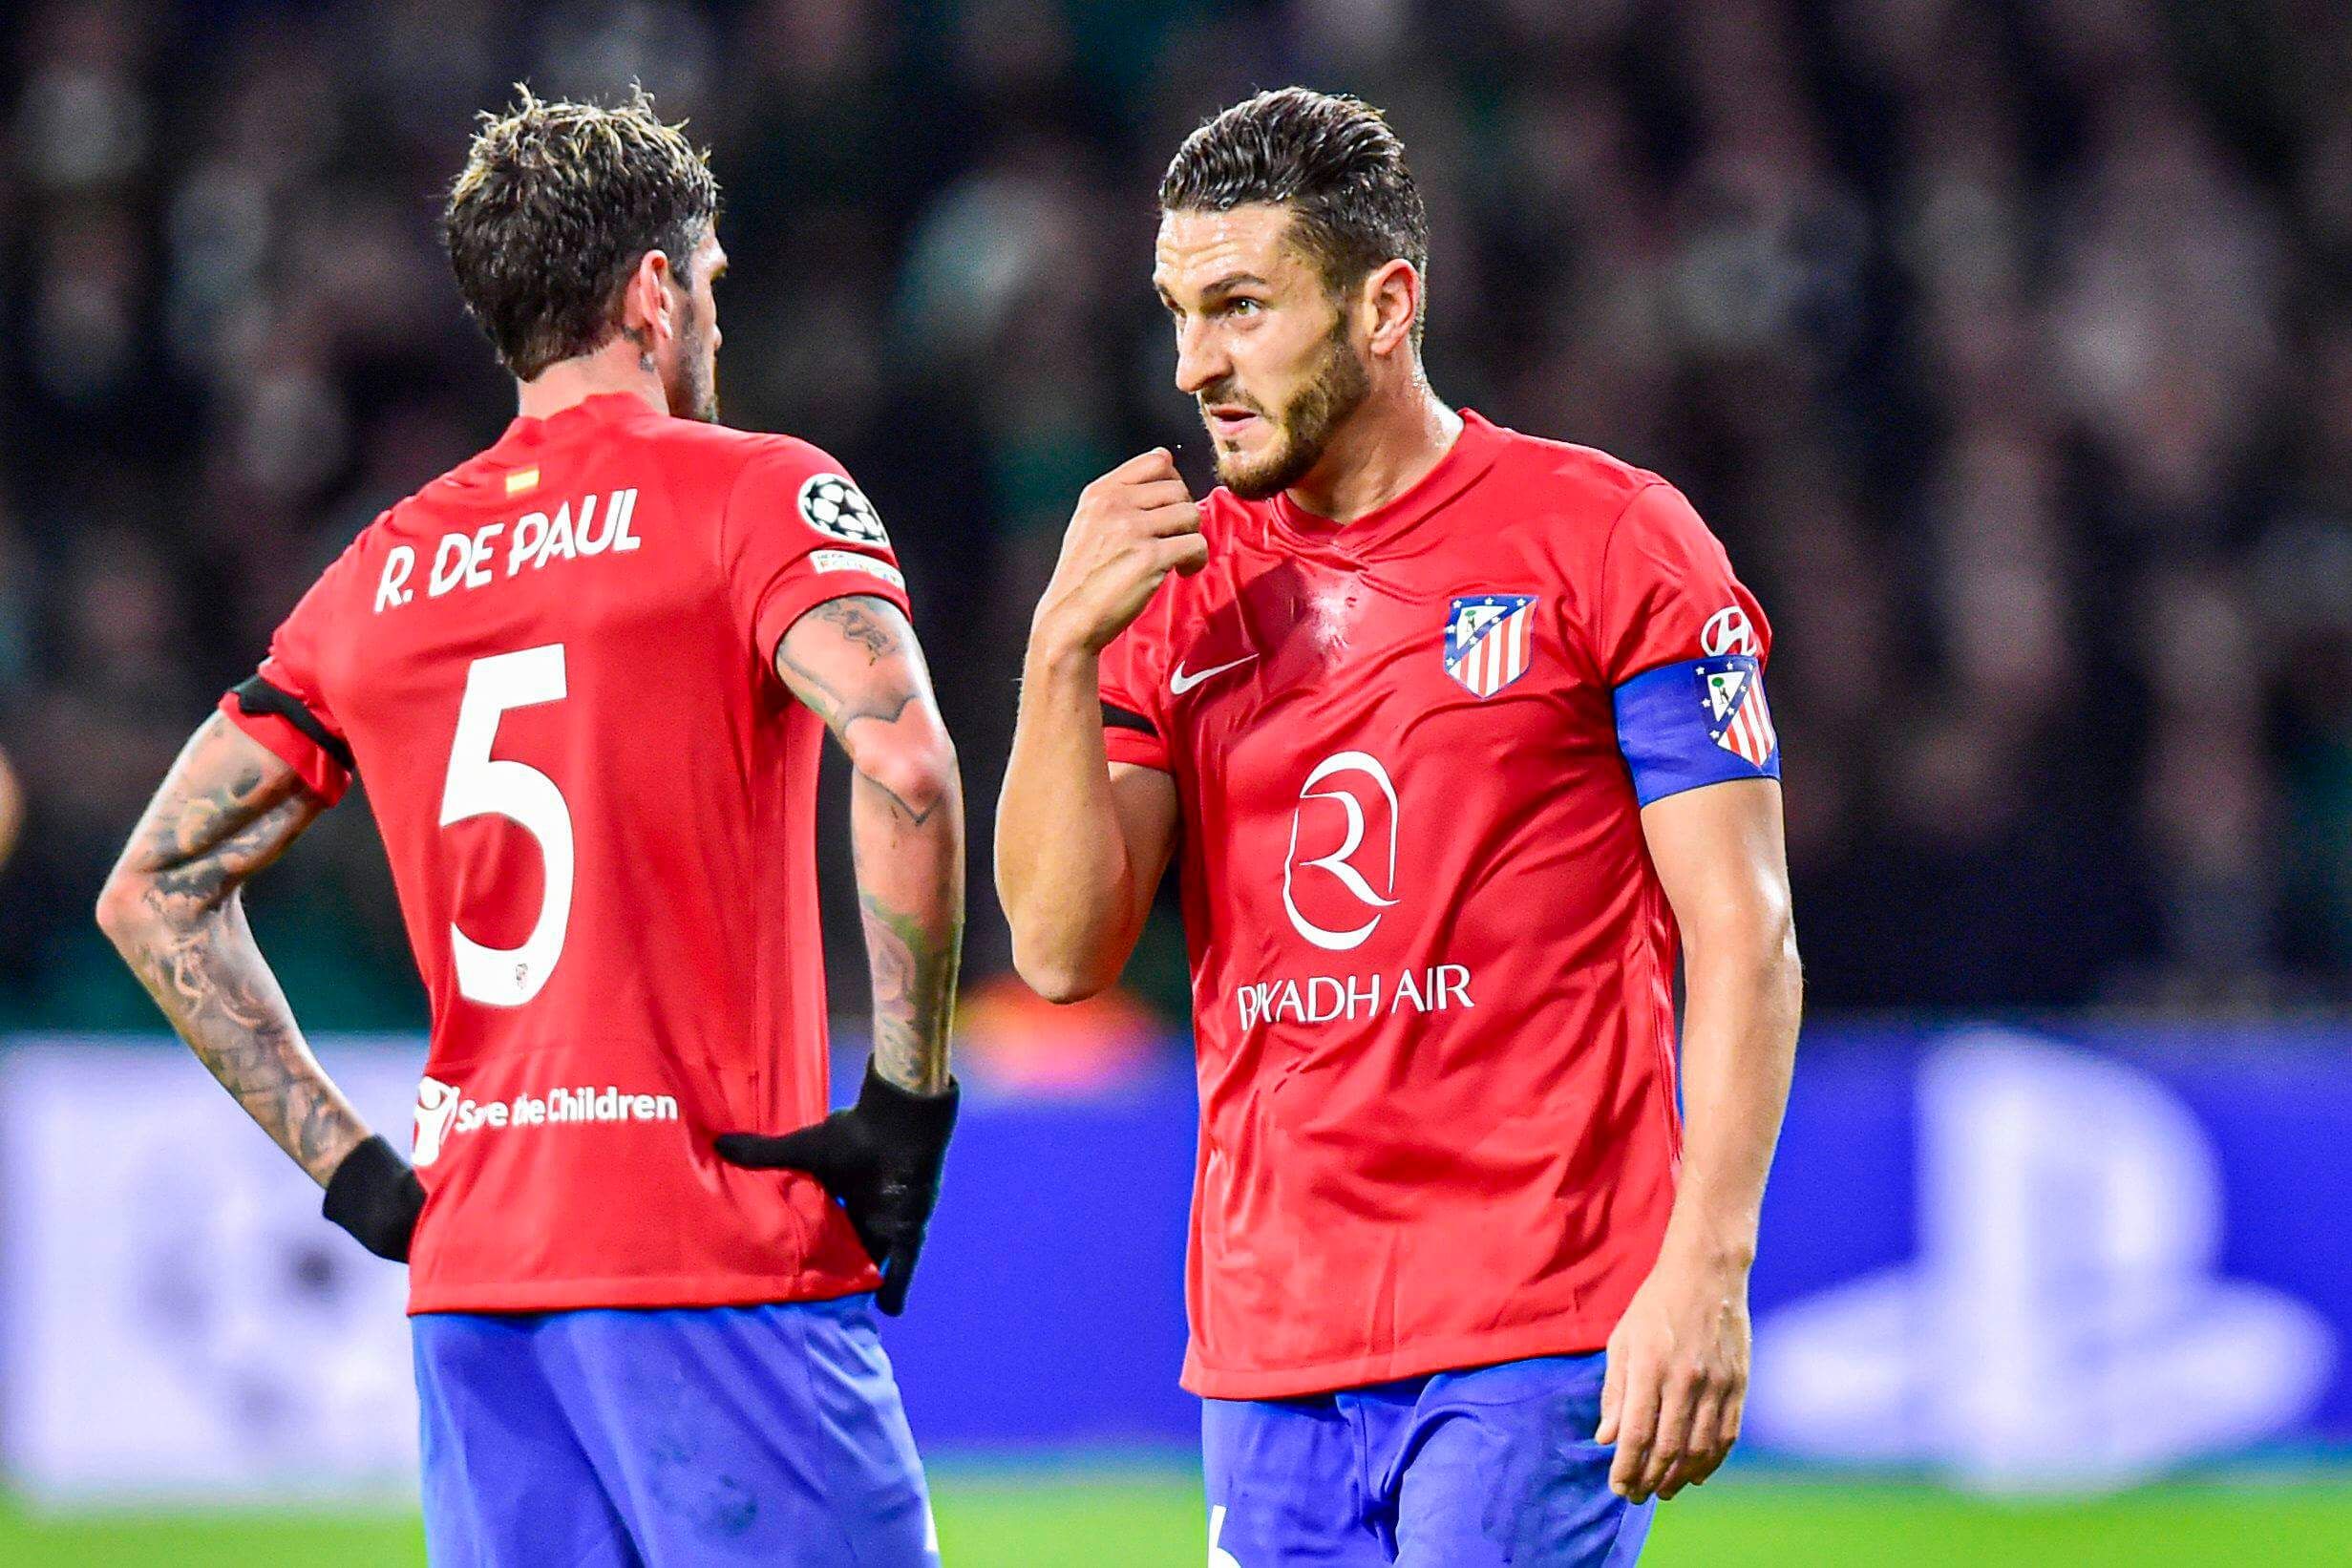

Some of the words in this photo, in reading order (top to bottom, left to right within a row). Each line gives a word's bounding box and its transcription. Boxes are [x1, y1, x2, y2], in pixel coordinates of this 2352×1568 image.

[373, 544, 415, 614] R.
[428, 521, 505, 598] DE
[507, 487, 642, 578] PAUL
[438, 642, 575, 1007] 5
[1390, 964, 1475, 1014] AIR
[547, 1086, 679, 1122] Children
